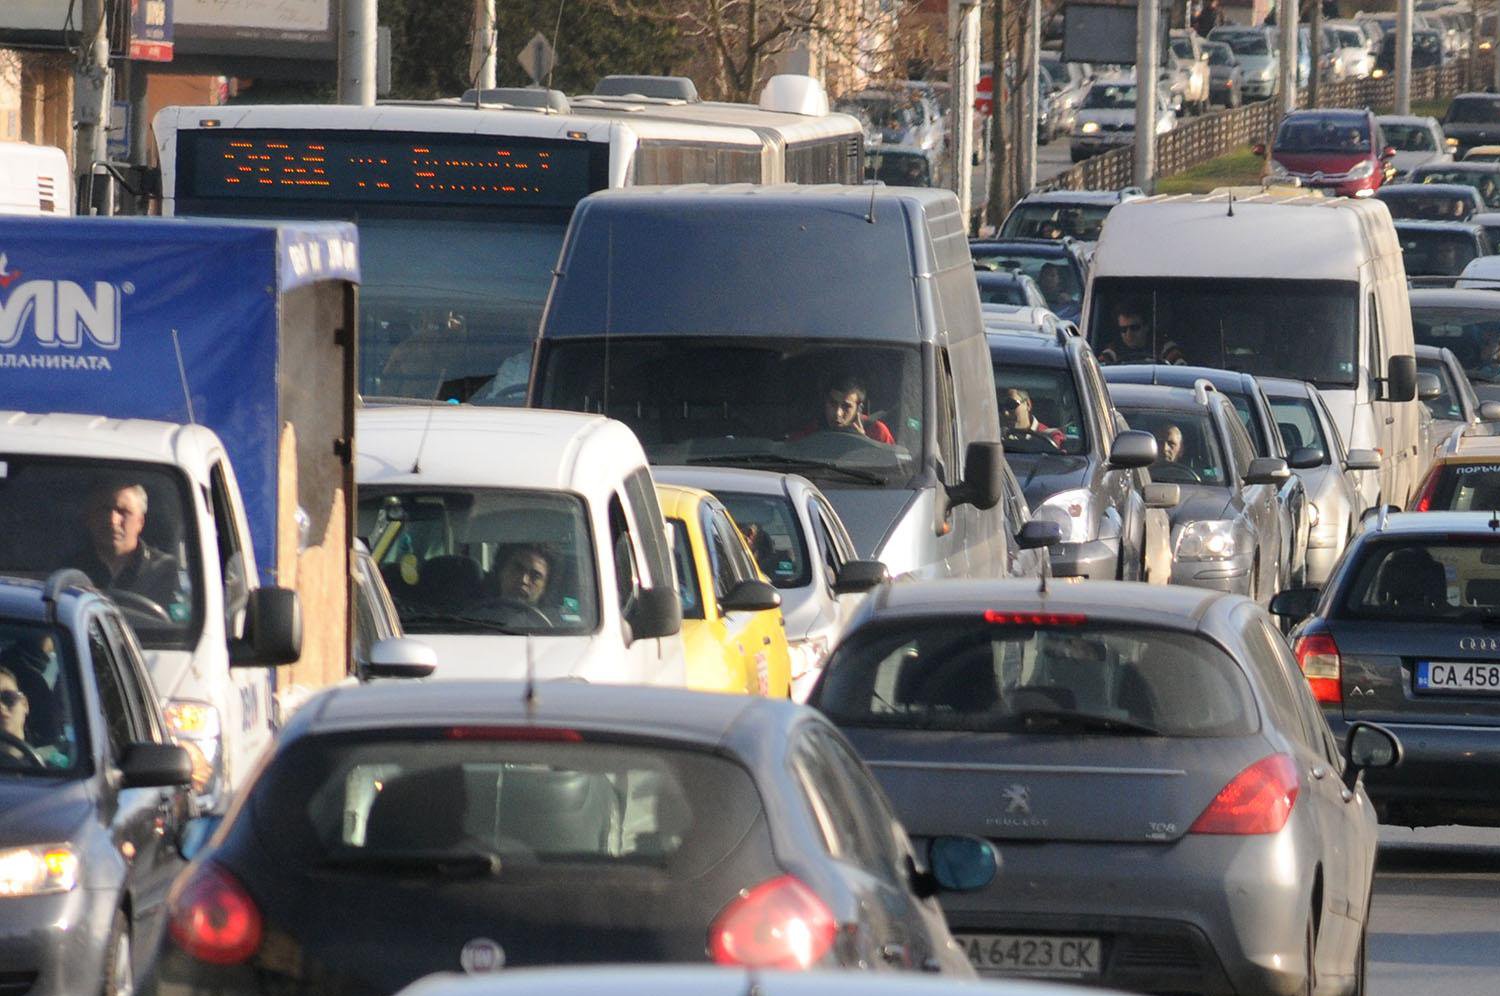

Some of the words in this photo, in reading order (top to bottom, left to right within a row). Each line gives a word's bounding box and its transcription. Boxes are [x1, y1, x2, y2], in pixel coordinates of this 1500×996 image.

[0, 353, 112, 371] ЛАНИНАТА
[1432, 666, 1457, 685] CA
[989, 940, 1054, 967] 6423
[1059, 942, 1093, 968] CK
